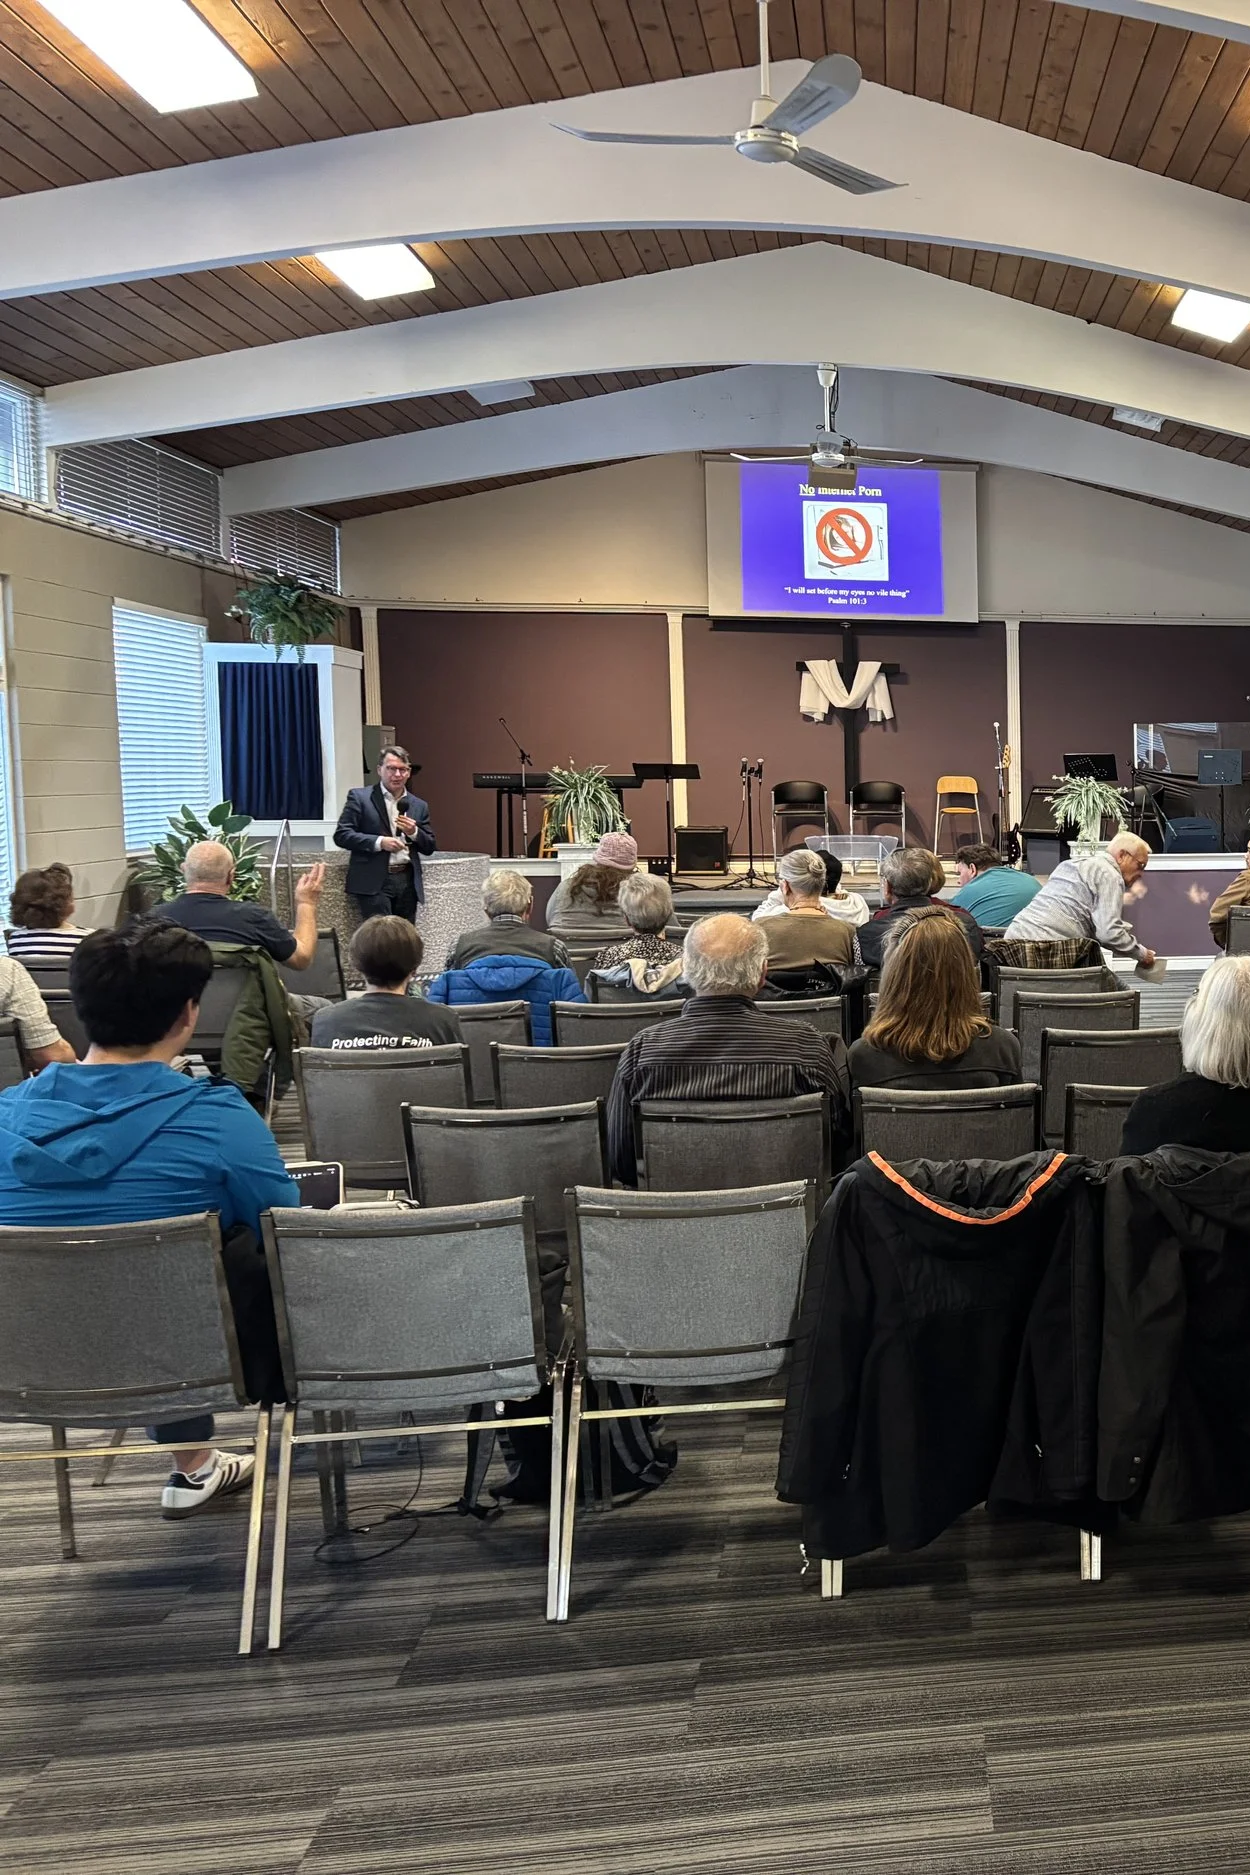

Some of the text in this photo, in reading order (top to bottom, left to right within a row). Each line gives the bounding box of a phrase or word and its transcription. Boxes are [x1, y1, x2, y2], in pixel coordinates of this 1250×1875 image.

[799, 484, 815, 496] No
[858, 486, 882, 496] Porn
[792, 586, 805, 594] will
[817, 587, 838, 595] before
[839, 589, 849, 597] my
[850, 589, 865, 597] eyes
[849, 597, 867, 605] 101:3
[332, 1035, 433, 1049] Protecting Faith
